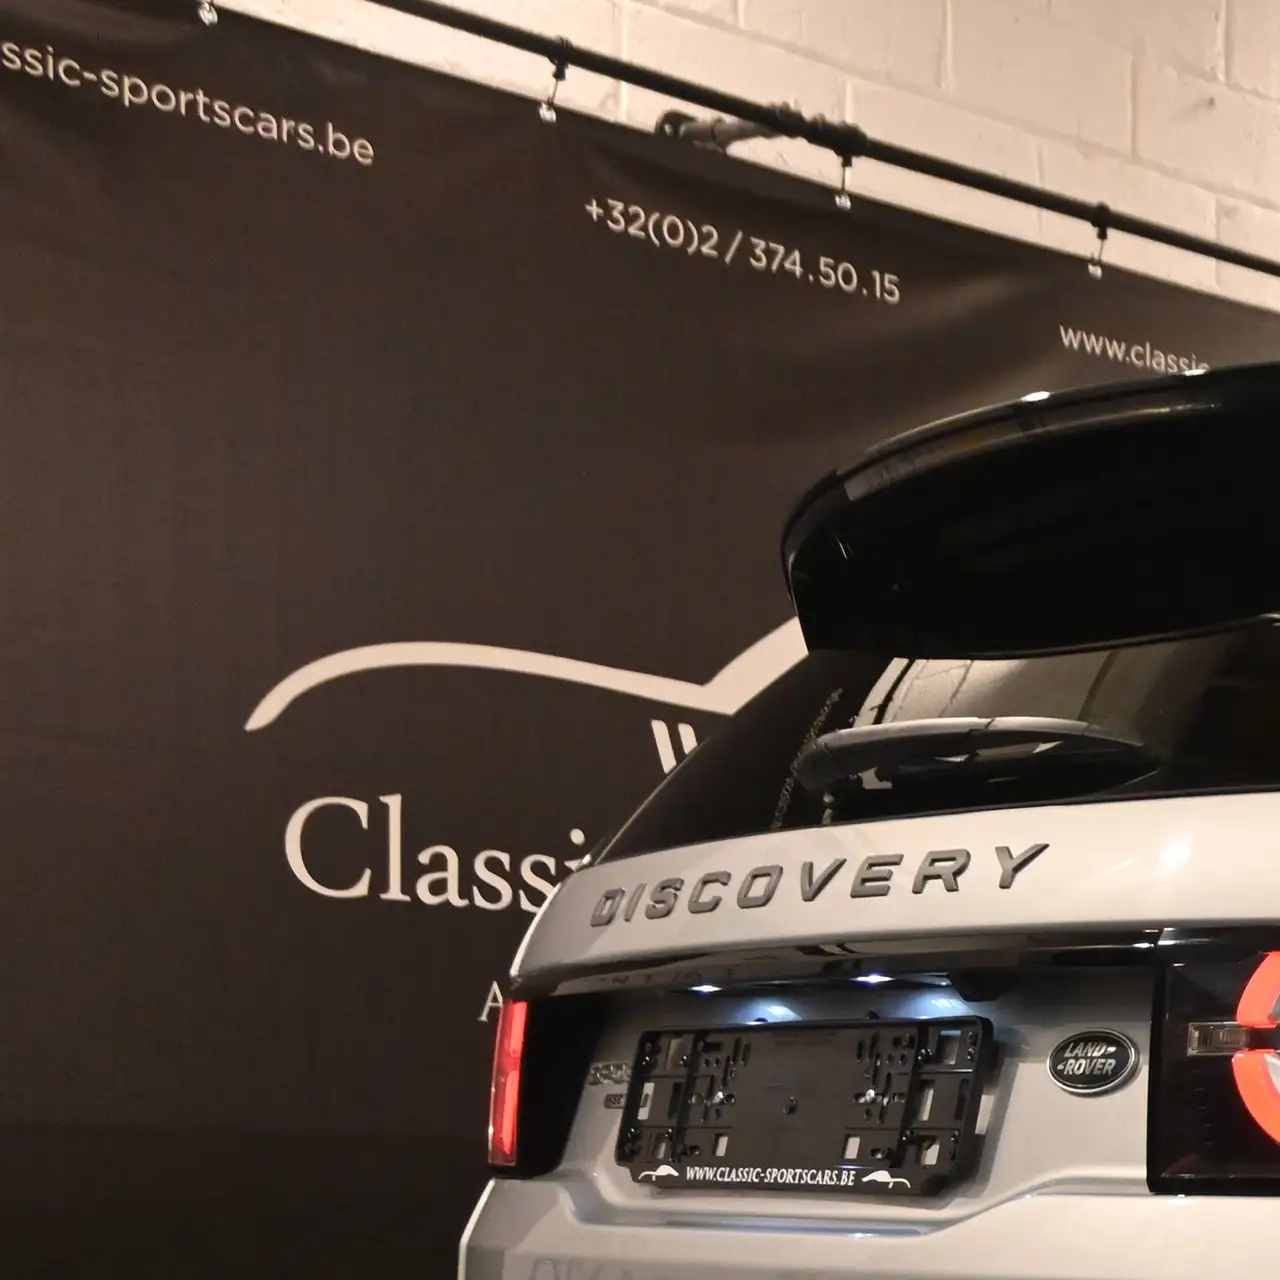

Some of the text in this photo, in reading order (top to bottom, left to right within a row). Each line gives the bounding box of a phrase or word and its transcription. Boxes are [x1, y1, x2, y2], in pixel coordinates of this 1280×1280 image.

[0, 40, 374, 167] ssic-sportscars.be
[590, 843, 1050, 927] DISCOVERY
[1063, 1042, 1108, 1057] LAND
[1063, 1058, 1116, 1075] ROVER
[685, 1165, 855, 1186] WWW.CLASSIC-SPORTSCARS.BE
